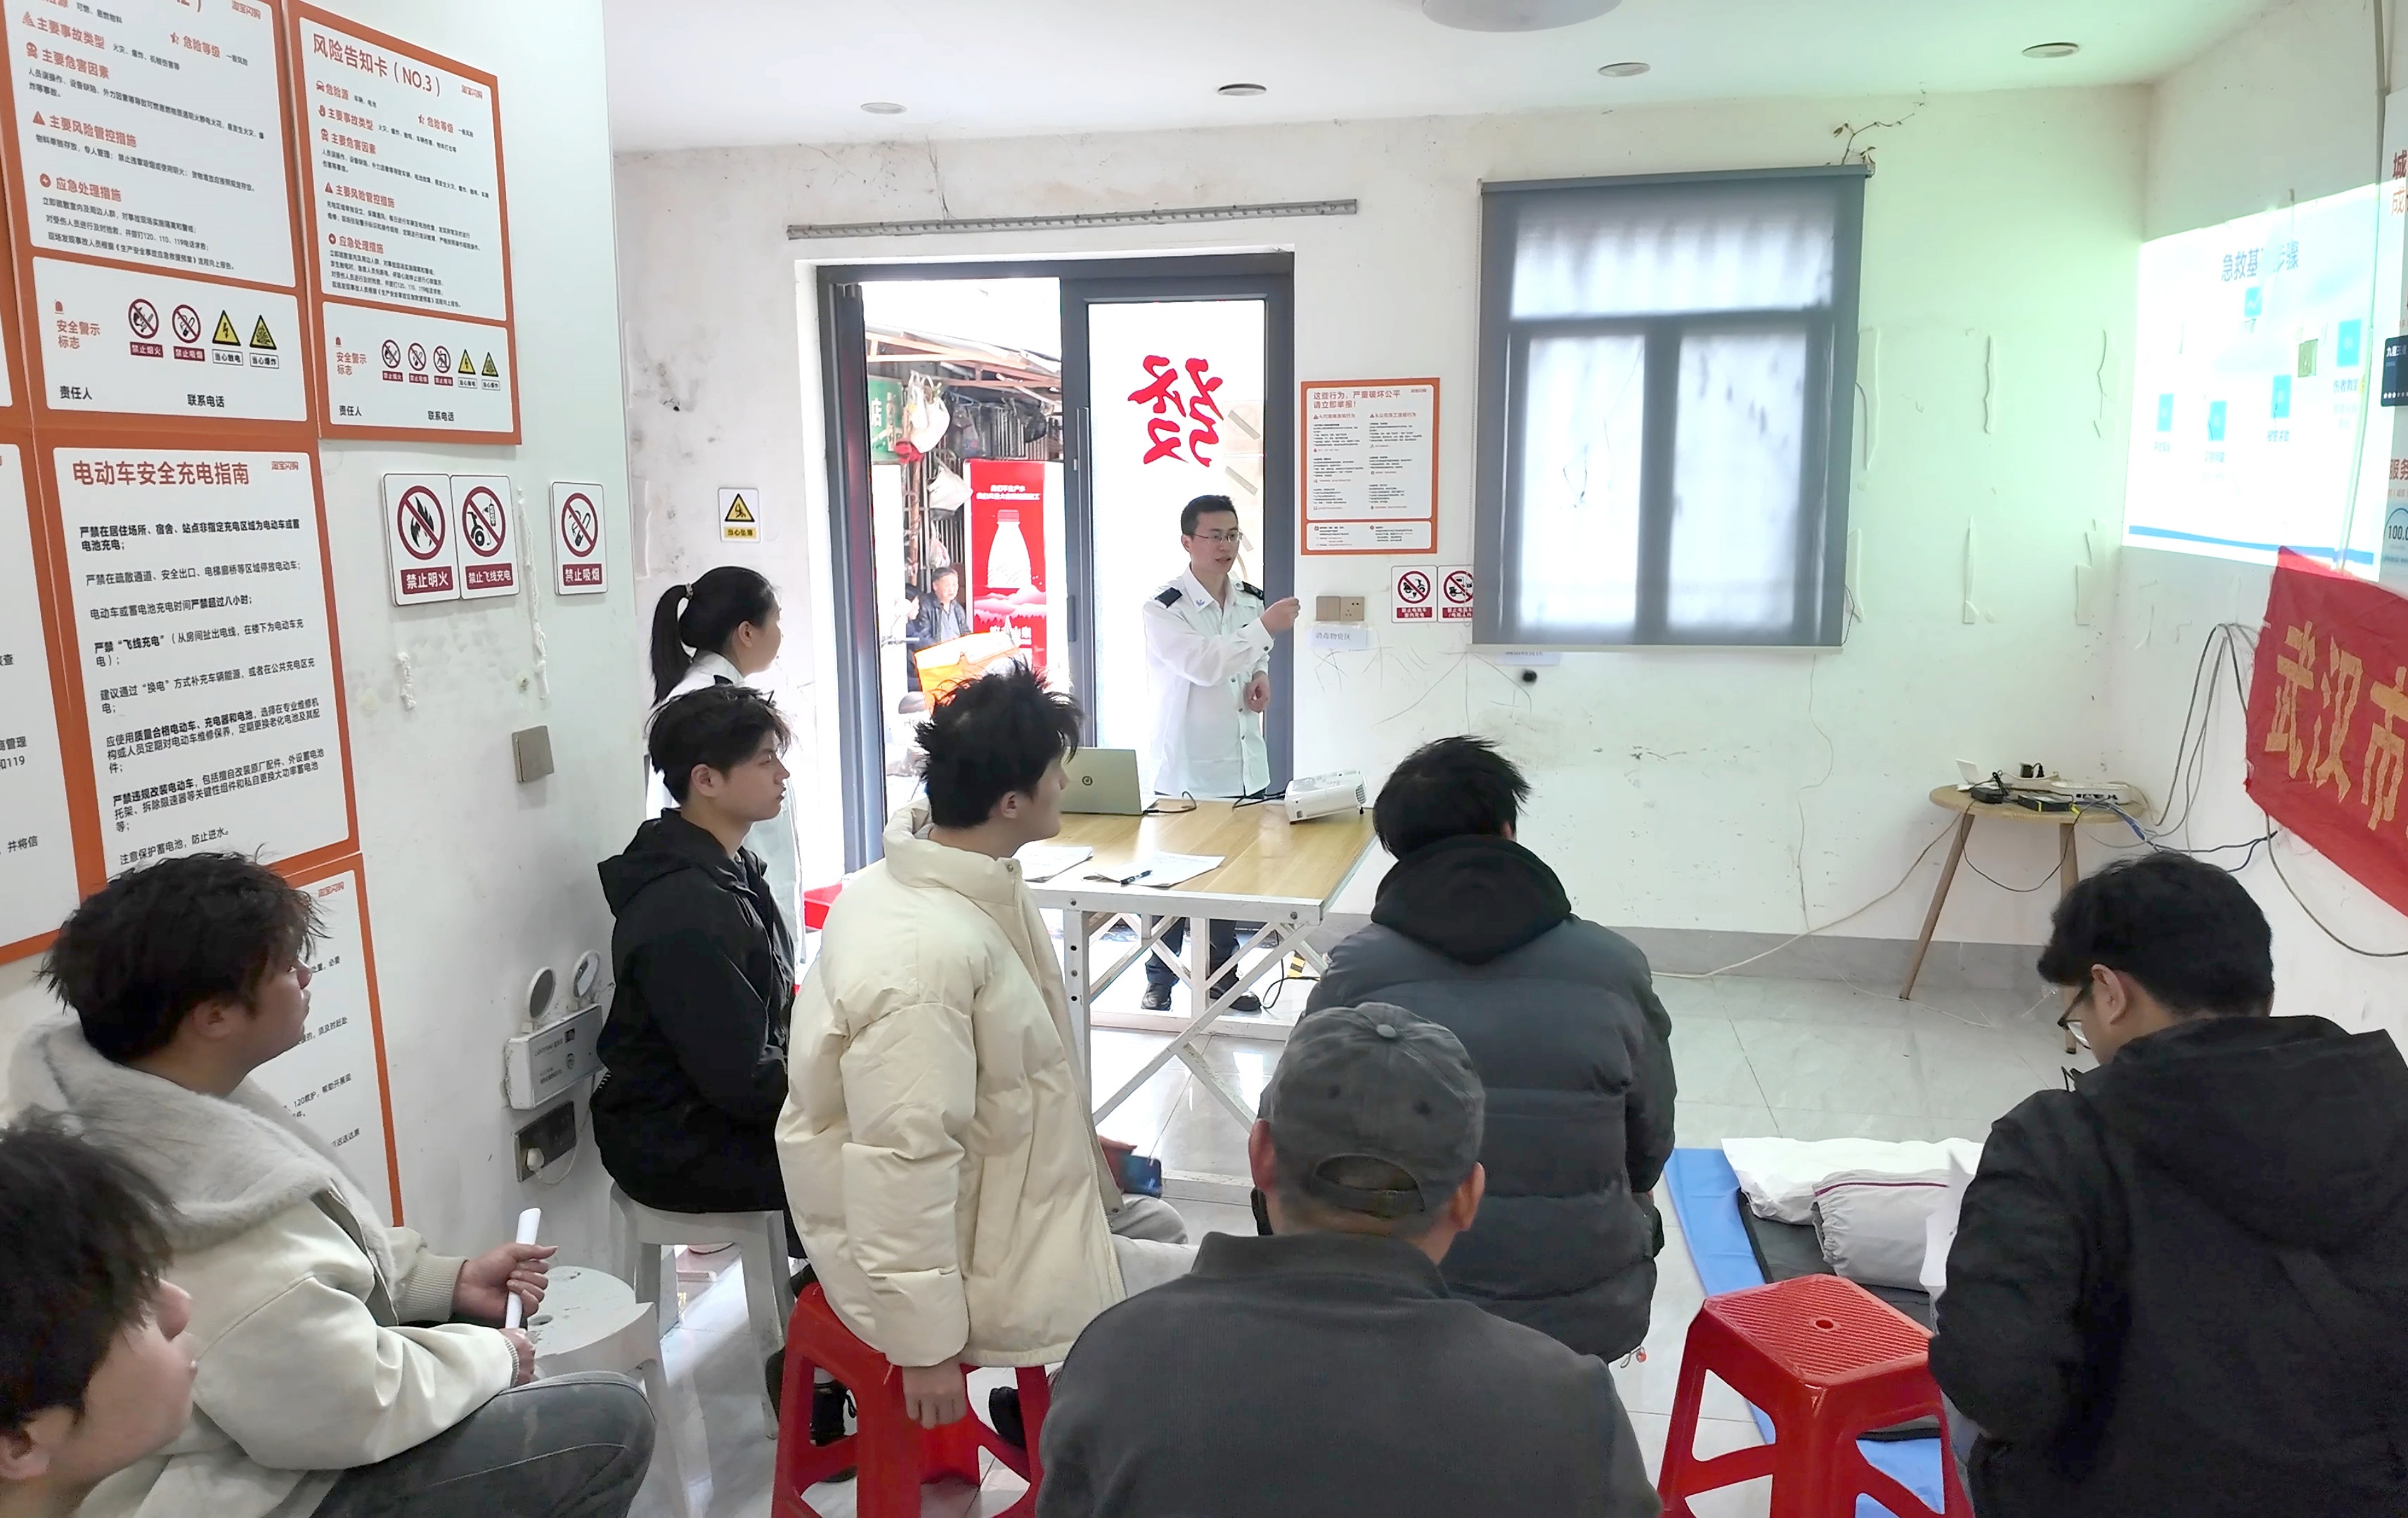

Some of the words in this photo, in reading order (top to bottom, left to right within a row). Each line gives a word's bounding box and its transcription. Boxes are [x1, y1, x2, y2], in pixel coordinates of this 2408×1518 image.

[38, 18, 105, 50] 主要事故类型
[183, 36, 220, 58] 危险等级
[42, 49, 110, 80] 主要危害因素
[325, 83, 349, 100] 危险源
[328, 108, 373, 131] 主要事故类型
[427, 117, 454, 134] 危险等级
[50, 115, 137, 147] 主要风险管控措施
[331, 133, 376, 155] 主要危害因素
[56, 177, 122, 202] 应急处理措施
[335, 185, 395, 208] 主要风险管控措施
[339, 236, 384, 254] 应急处理措施
[2221, 241, 2299, 282] 急救基步骤
[56, 319, 100, 336] 安全警示
[58, 335, 80, 349] 标志
[132, 344, 162, 356] 禁止烟火
[175, 349, 204, 361] 禁止吸烟
[214, 352, 241, 363] 当心触电
[251, 356, 277, 367] 当心爆炸
[336, 351, 366, 364] 安全警示
[337, 364, 352, 376] 标志
[60, 386, 92, 401] 责任人
[187, 394, 224, 408] 联系电话
[339, 406, 362, 416] 责任人
[428, 411, 454, 421] 联系电话
[73, 460, 249, 485] 电动车安全充电指南
[82, 539, 125, 552] 电池充电；
[406, 572, 449, 589] 禁止明火
[468, 570, 512, 584] 禁止飞线充电
[564, 568, 600, 582] 禁止吸烟
[90, 594, 251, 619] 电动车或蓄电池充电时间严禁超过八小时；
[102, 703, 115, 714] 电；
[2264, 620, 2408, 831] 武汉市
[109, 762, 122, 774] 件；
[116, 821, 129, 832] 等；
[120, 826, 229, 865] 注意保护蓄电池，防止进水。
